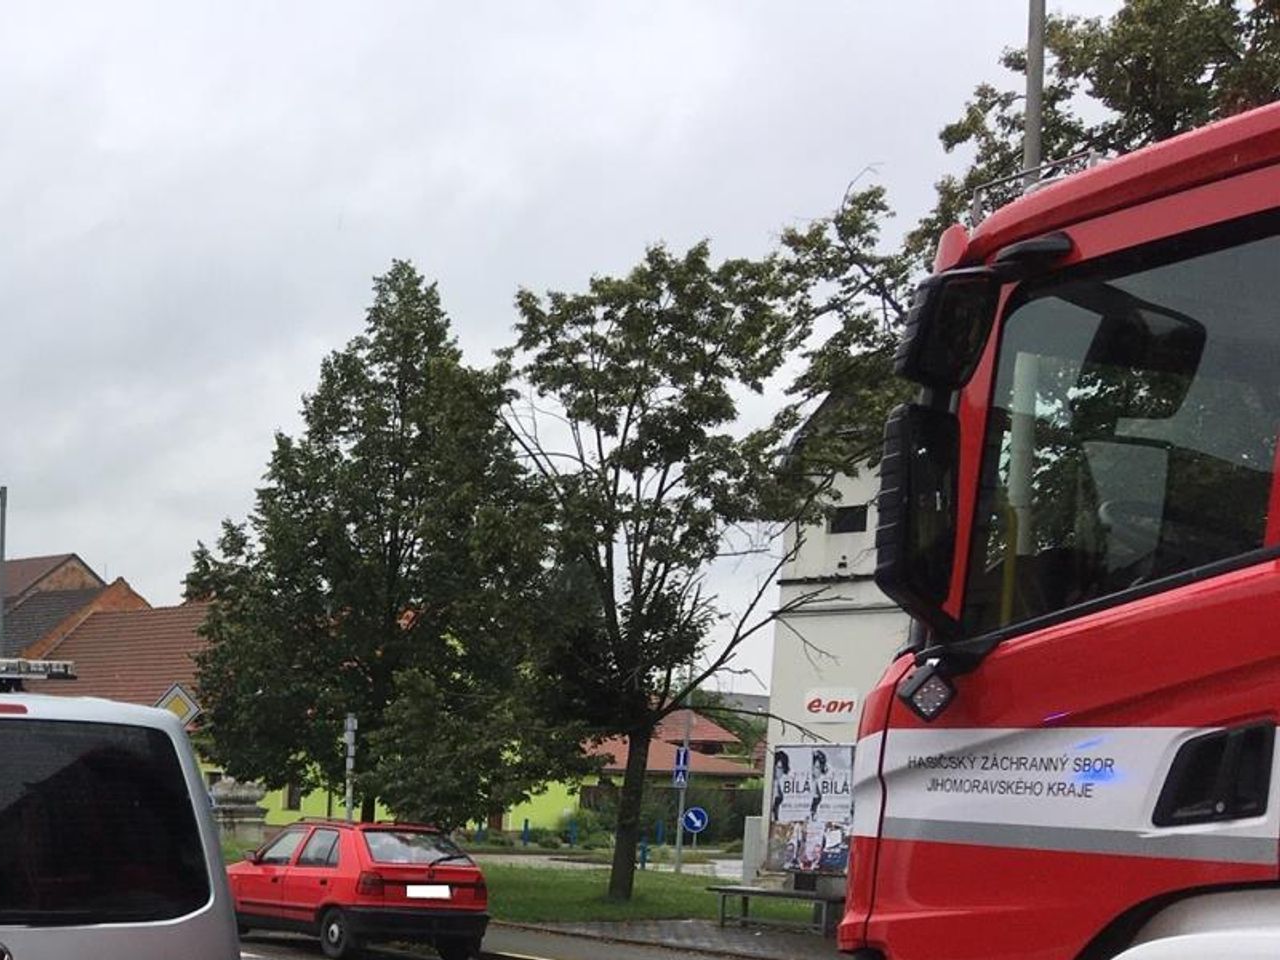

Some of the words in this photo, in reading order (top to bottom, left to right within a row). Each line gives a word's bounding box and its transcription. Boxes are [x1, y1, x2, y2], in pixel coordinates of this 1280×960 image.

[981, 753, 1069, 772] ZÁCHRANNÝ
[1073, 757, 1115, 773] SBOR
[927, 777, 1043, 796] JIHOMORAVSKÉHO
[1046, 782, 1095, 798] KRAJE
